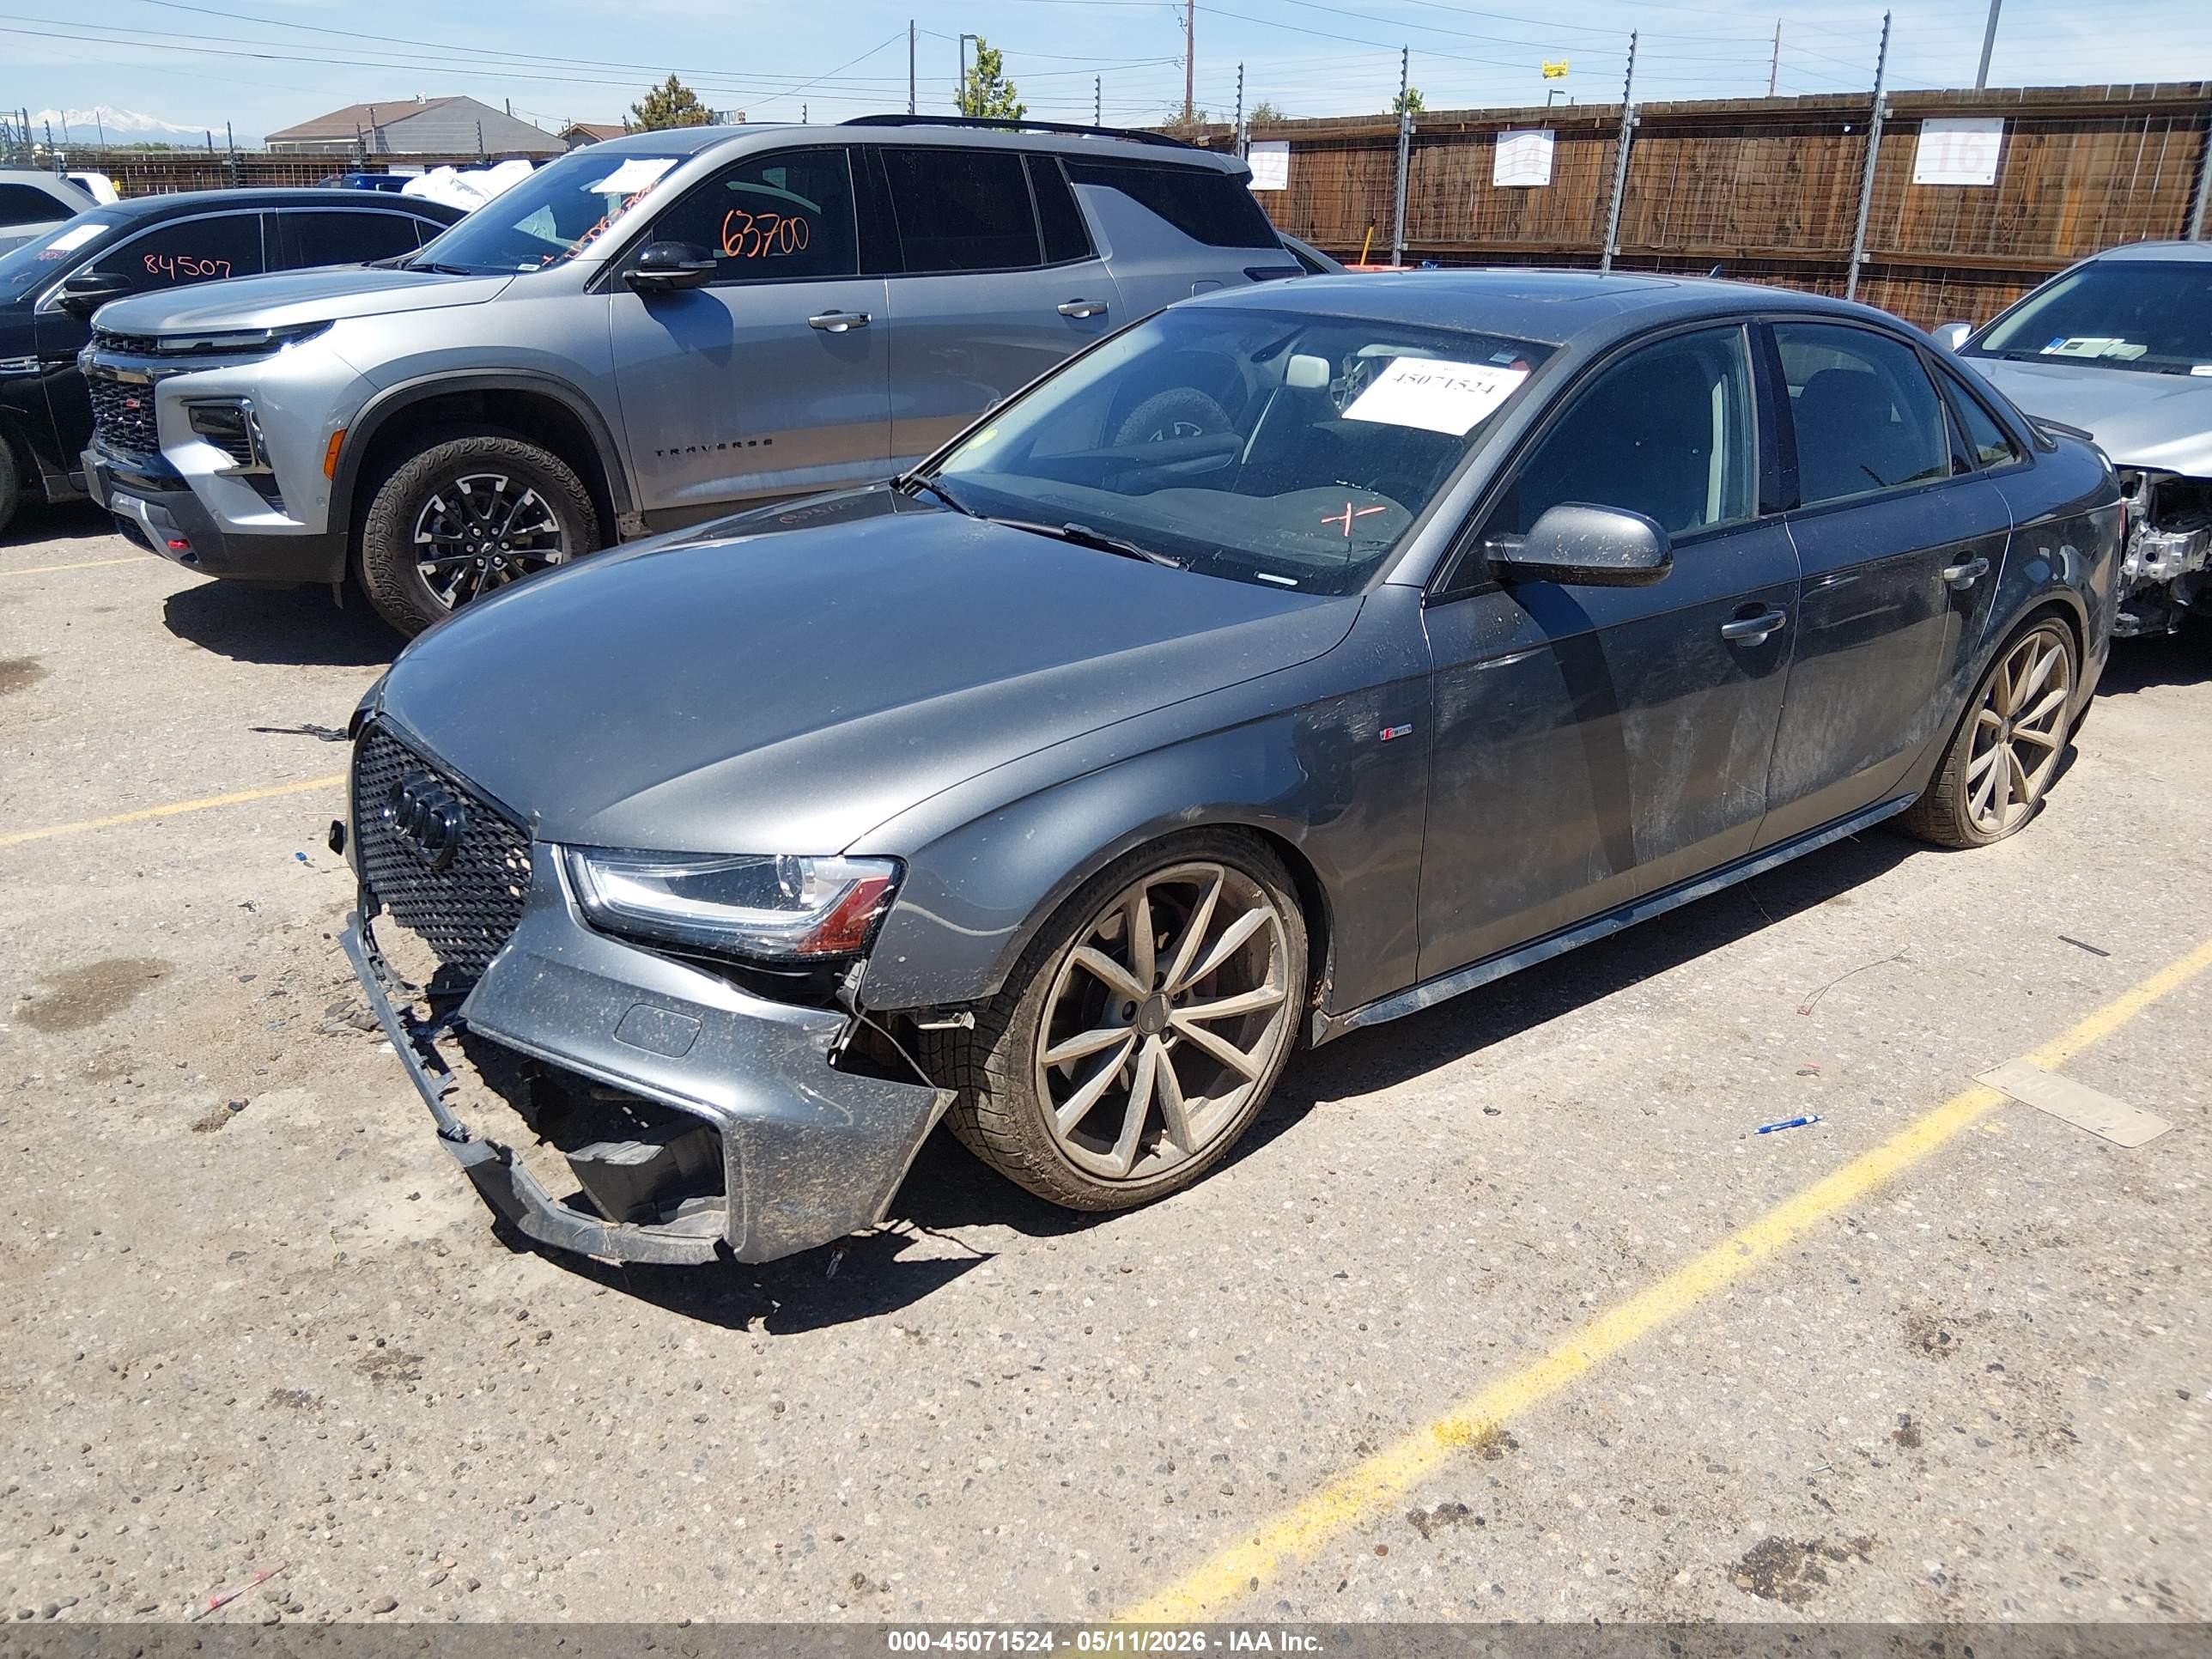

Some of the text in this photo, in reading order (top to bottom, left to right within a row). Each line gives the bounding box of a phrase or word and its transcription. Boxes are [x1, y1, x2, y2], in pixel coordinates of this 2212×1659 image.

[1936, 129, 1985, 173] 16
[722, 209, 809, 258] 63700
[143, 254, 232, 281] 84507
[655, 439, 773, 457] TRAVERSE
